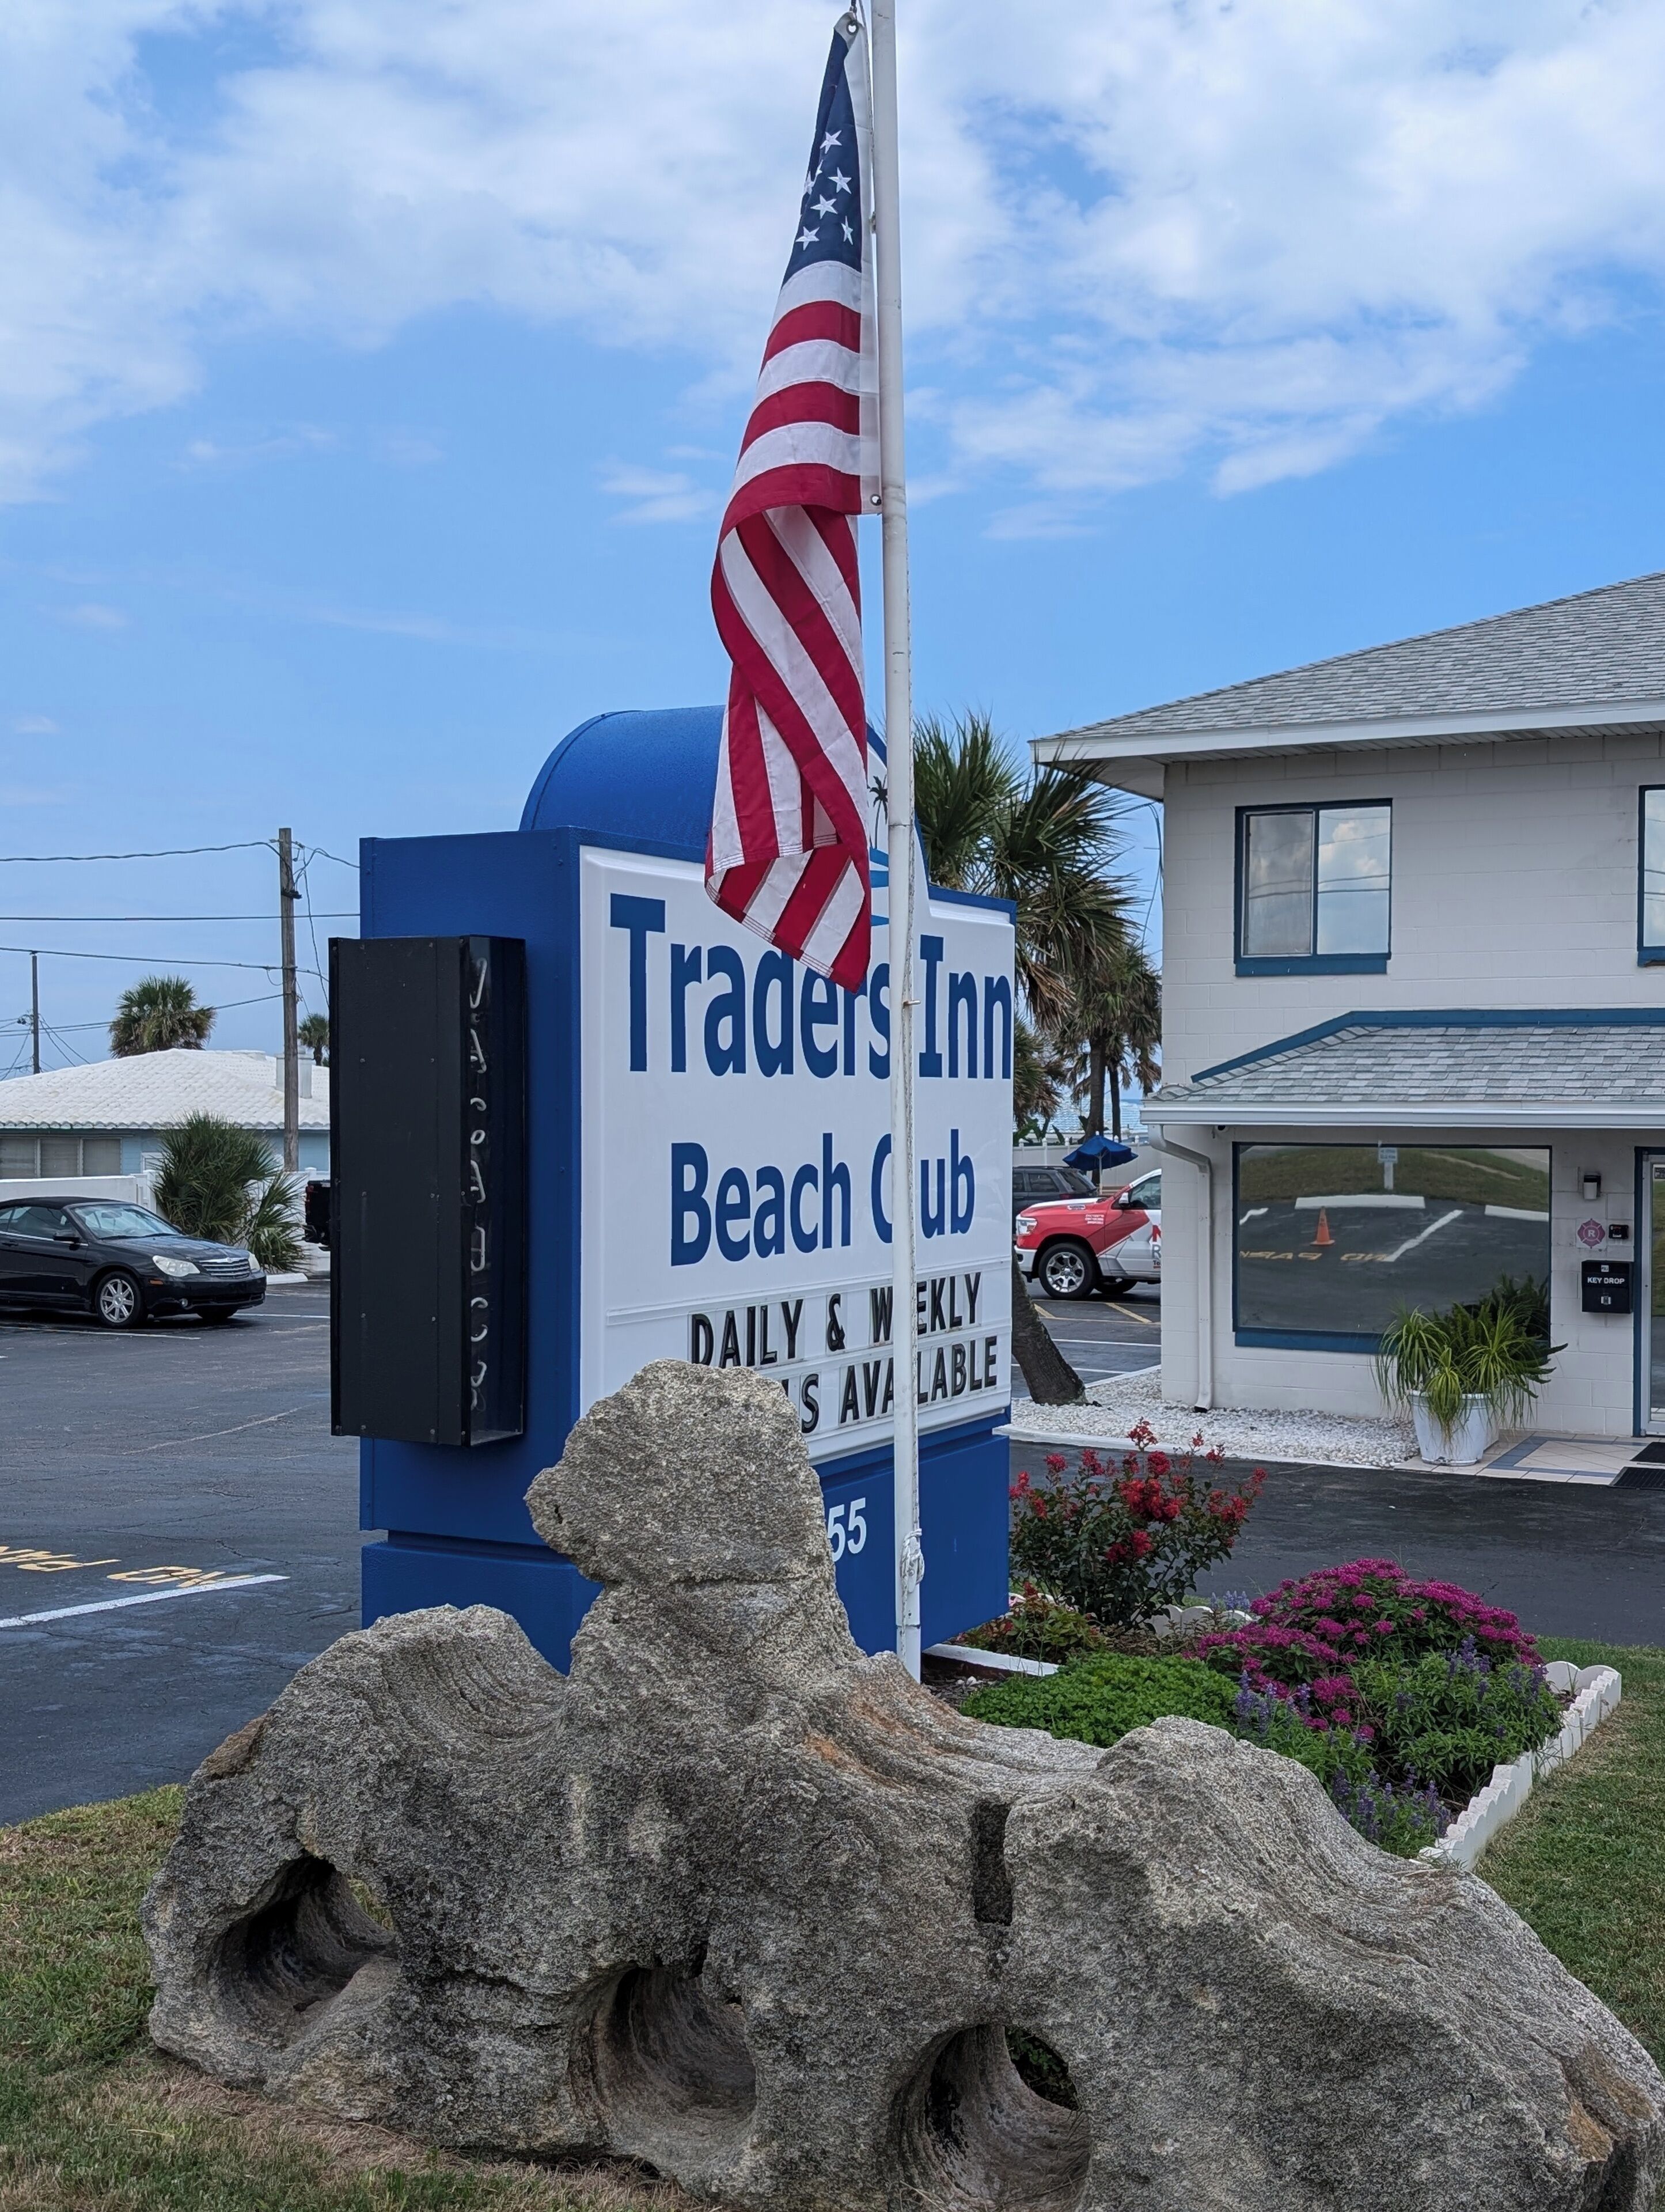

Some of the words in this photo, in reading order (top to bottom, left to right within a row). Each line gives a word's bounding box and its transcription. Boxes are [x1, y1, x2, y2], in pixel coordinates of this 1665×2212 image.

[610, 893, 891, 1080] Traders
[919, 934, 1011, 1080] Inn
[671, 1132, 851, 1266] Beach
[871, 1129, 975, 1243] Cub
[692, 1300, 803, 1369] DAILY
[827, 1293, 845, 1352] &
[871, 1272, 981, 1343] WEKLY
[840, 1336, 997, 1423] AVALABLE
